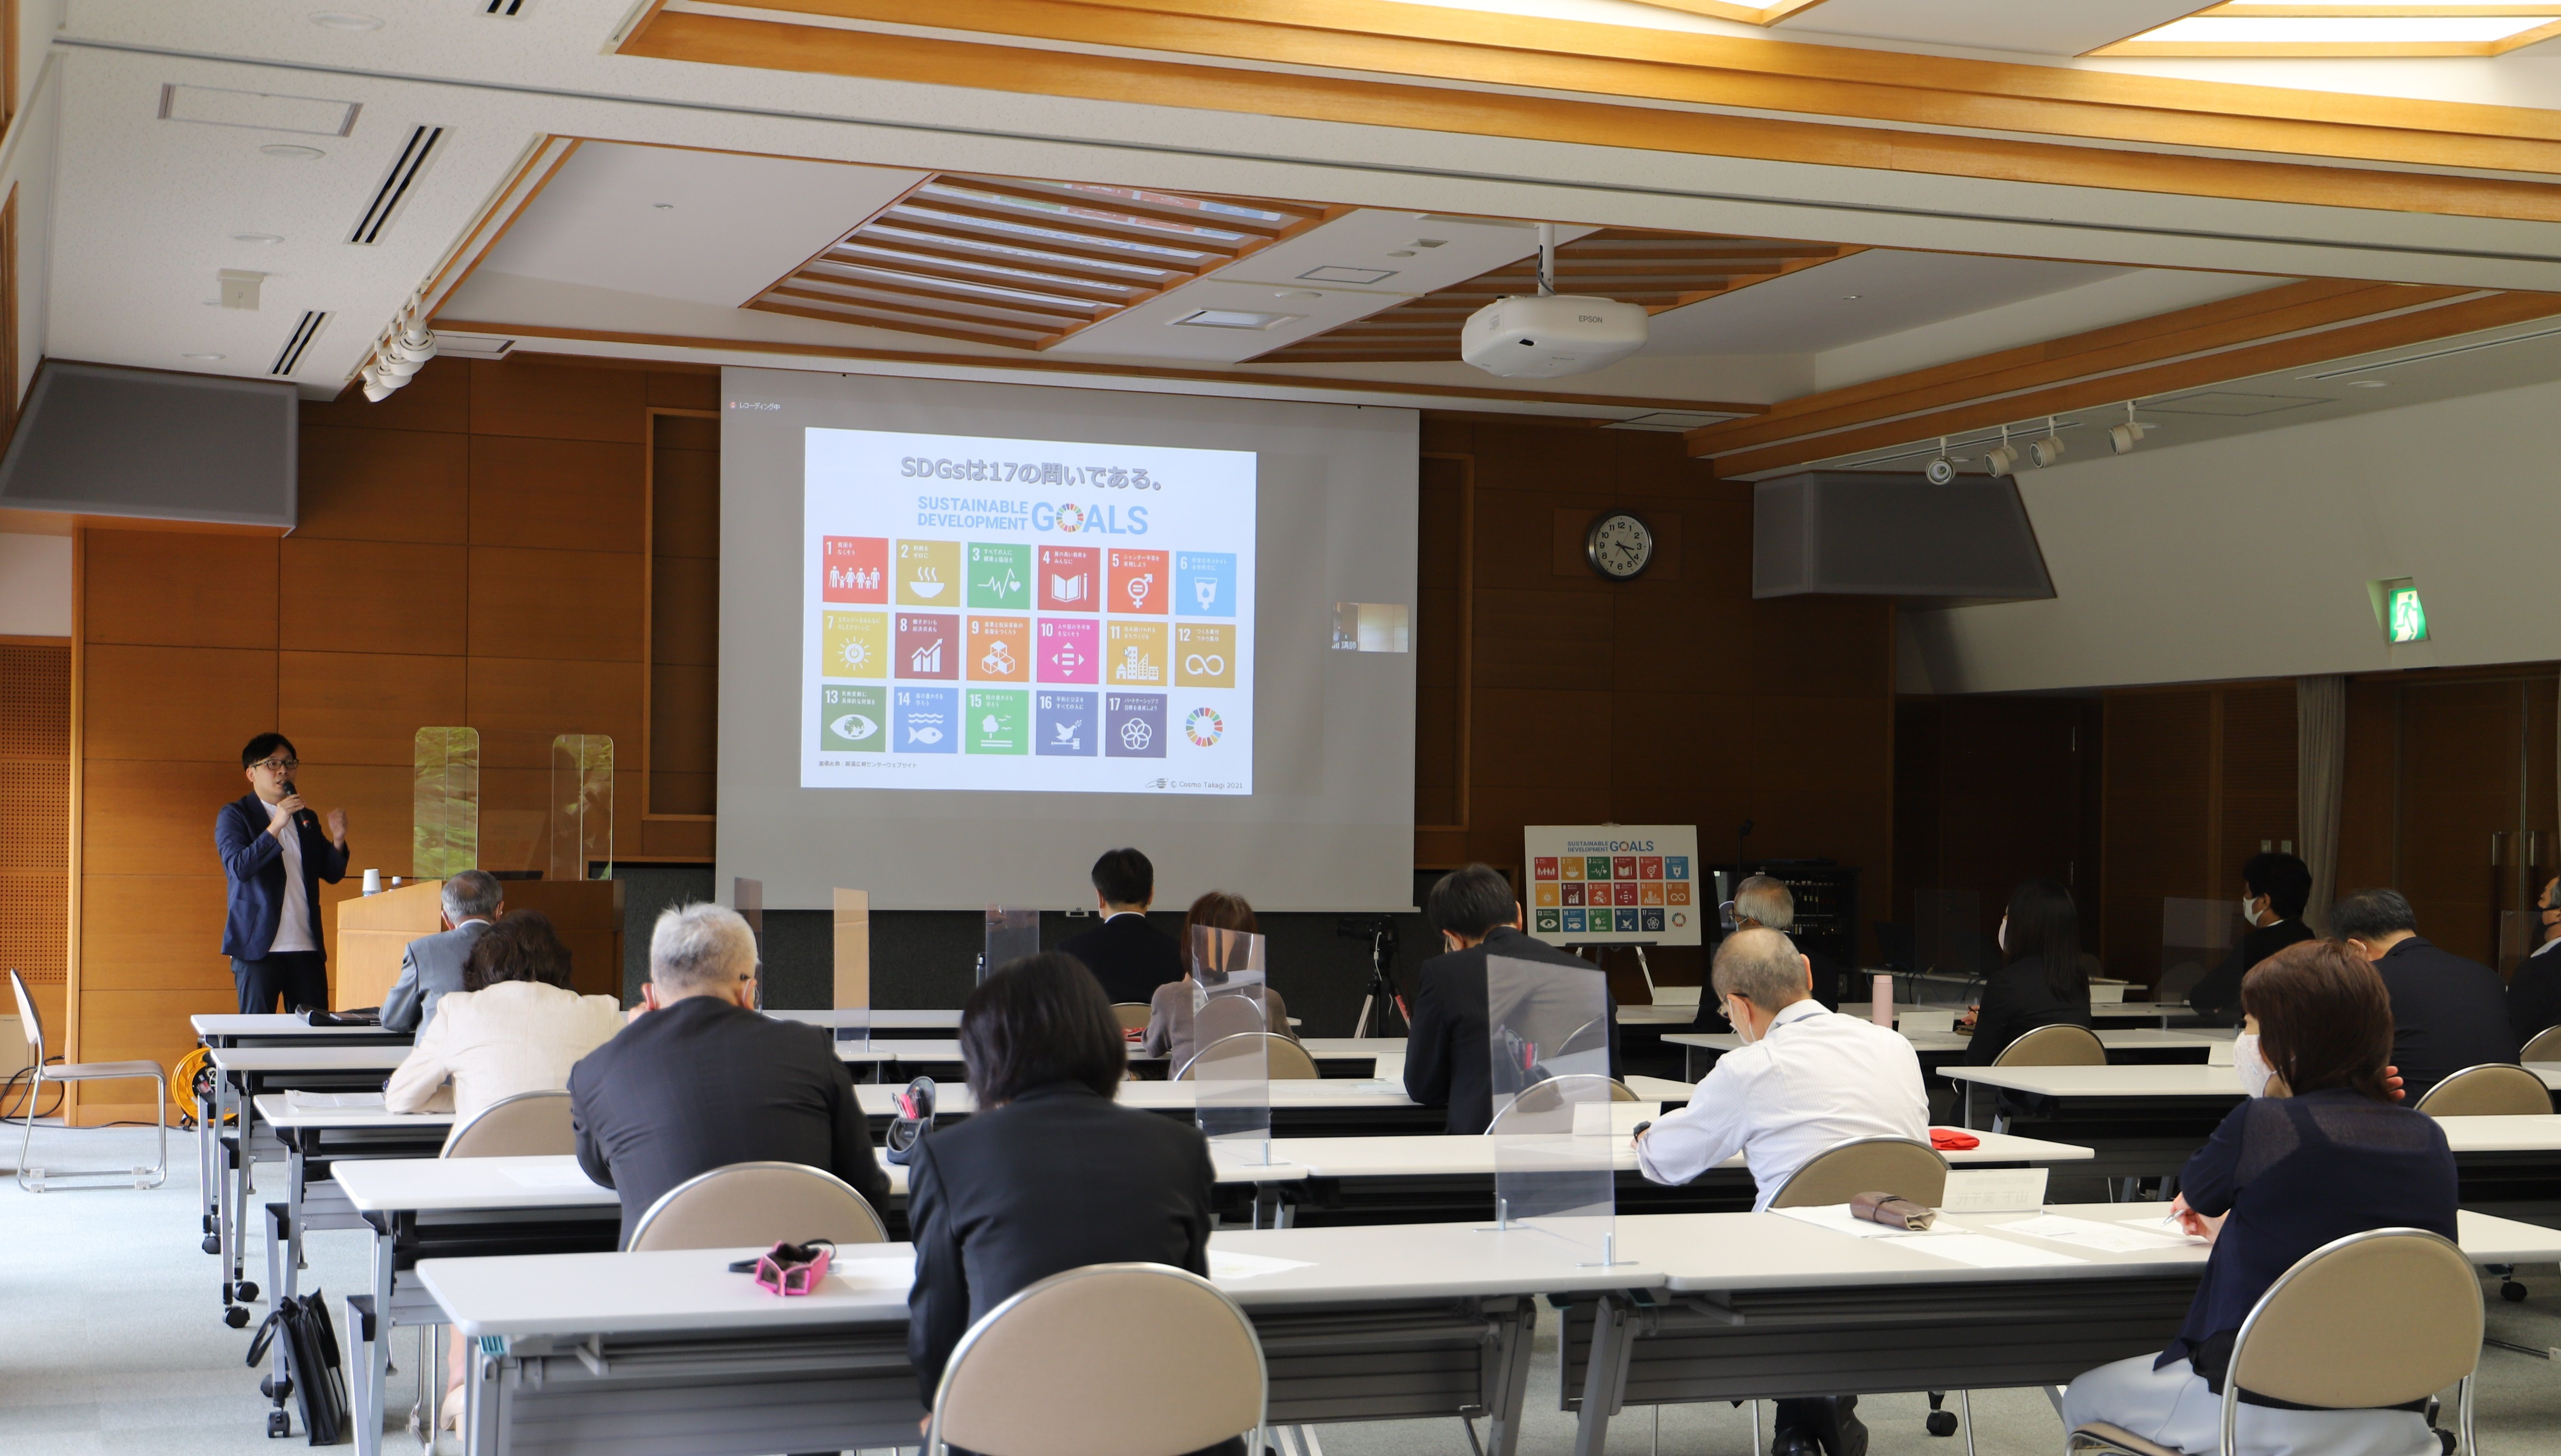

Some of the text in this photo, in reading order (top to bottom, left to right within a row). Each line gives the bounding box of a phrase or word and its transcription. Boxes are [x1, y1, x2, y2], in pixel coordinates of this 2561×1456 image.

[1578, 315, 1603, 323] EPSON
[739, 402, 780, 410] レコーディング中
[900, 456, 1162, 491] SDGsは17の問いである。
[918, 496, 1029, 514] SUSTAINABLE
[918, 514, 1029, 531] DEVELOPMENT
[1031, 502, 1149, 535] GOALS
[826, 541, 832, 555] 1
[901, 544, 909, 558] 2
[972, 548, 980, 561] 3
[1043, 551, 1050, 564] 4
[1112, 554, 1119, 567] 5
[1180, 557, 1187, 570] 6
[827, 615, 834, 629] 7
[900, 618, 907, 631] 8
[971, 621, 979, 635] 9
[1041, 623, 1054, 636] 10
[1110, 626, 1120, 639] 11
[1178, 628, 1191, 642] 12
[1341, 641, 1357, 650] 講師
[825, 690, 838, 704] 13
[897, 692, 911, 706] 14
[969, 694, 982, 707] 15
[1040, 696, 1052, 710] 16
[1109, 697, 1121, 711] 17
[1610, 841, 1654, 852] GOALS
